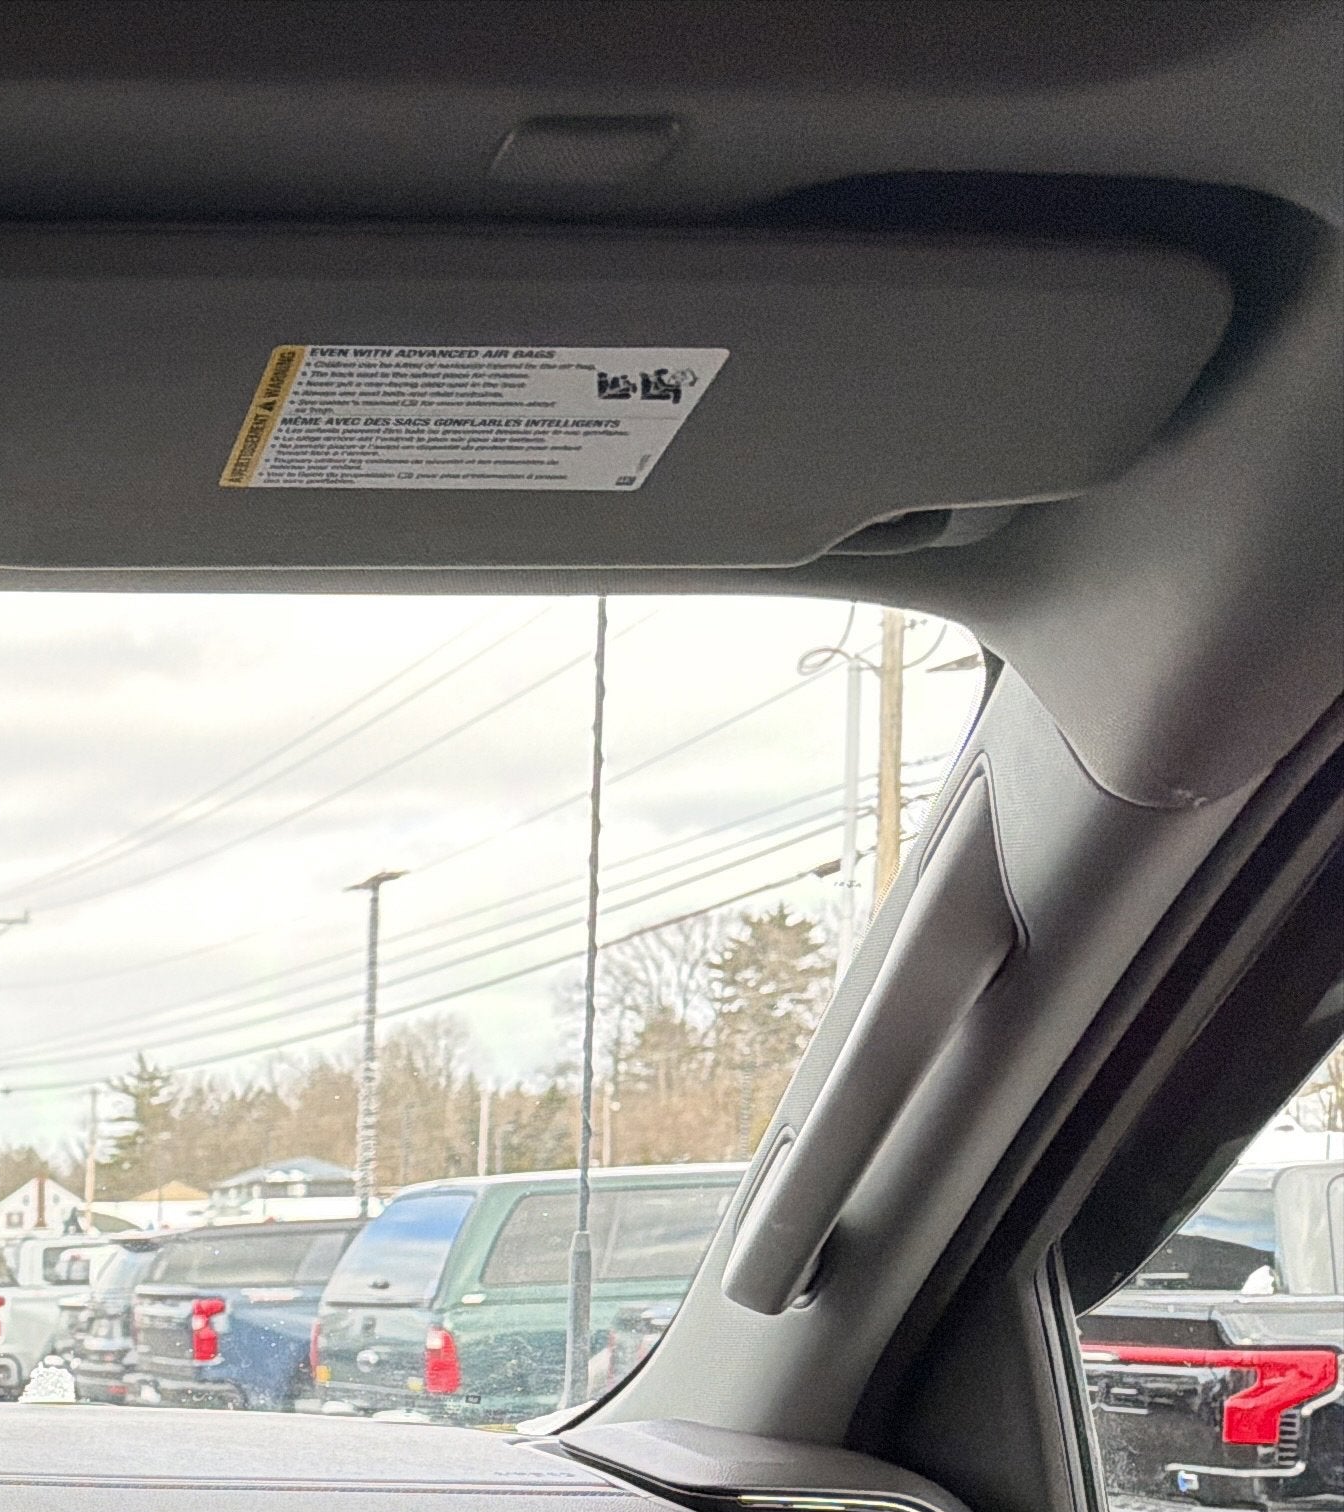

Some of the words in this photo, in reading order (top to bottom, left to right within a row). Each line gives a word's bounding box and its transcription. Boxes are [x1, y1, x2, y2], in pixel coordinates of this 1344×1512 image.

[310, 348, 348, 357] EVEN
[352, 349, 392, 357] WITH
[395, 349, 479, 358] ADVANCED
[482, 350, 509, 358] AIR
[512, 350, 556, 358] BAGS
[325, 418, 361, 426] AVEC
[363, 418, 392, 426] DES
[394, 418, 429, 426] SACS
[434, 419, 522, 427] GONFLABLES
[525, 420, 620, 428] INTELLIGENTS
